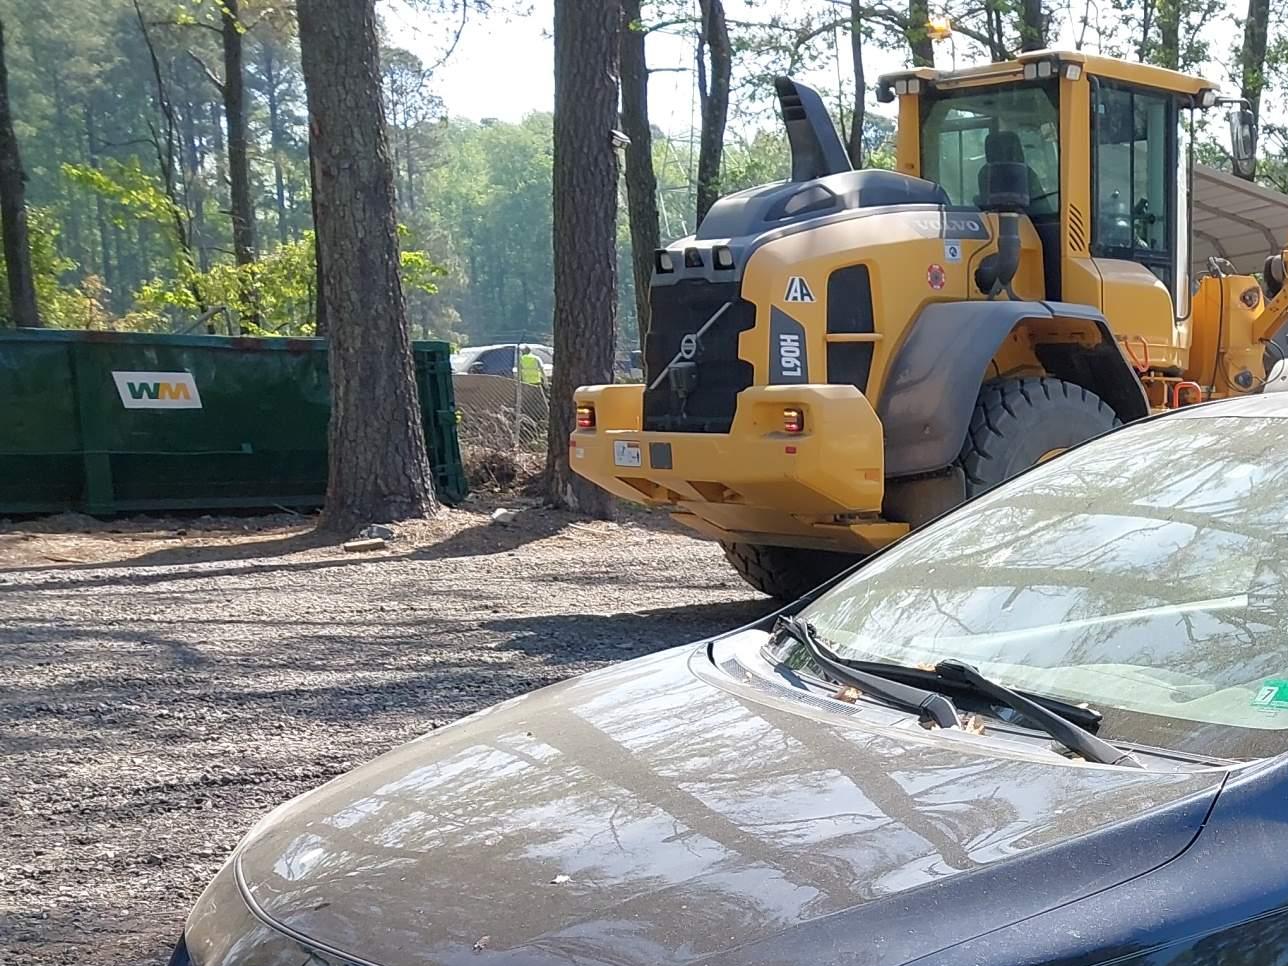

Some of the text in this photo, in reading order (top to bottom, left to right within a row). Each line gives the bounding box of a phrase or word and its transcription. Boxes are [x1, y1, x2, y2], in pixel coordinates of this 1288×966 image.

[916, 220, 980, 231] VOLVO
[779, 334, 802, 377] L90H
[127, 382, 191, 399] WM
[1262, 689, 1274, 700] 7
